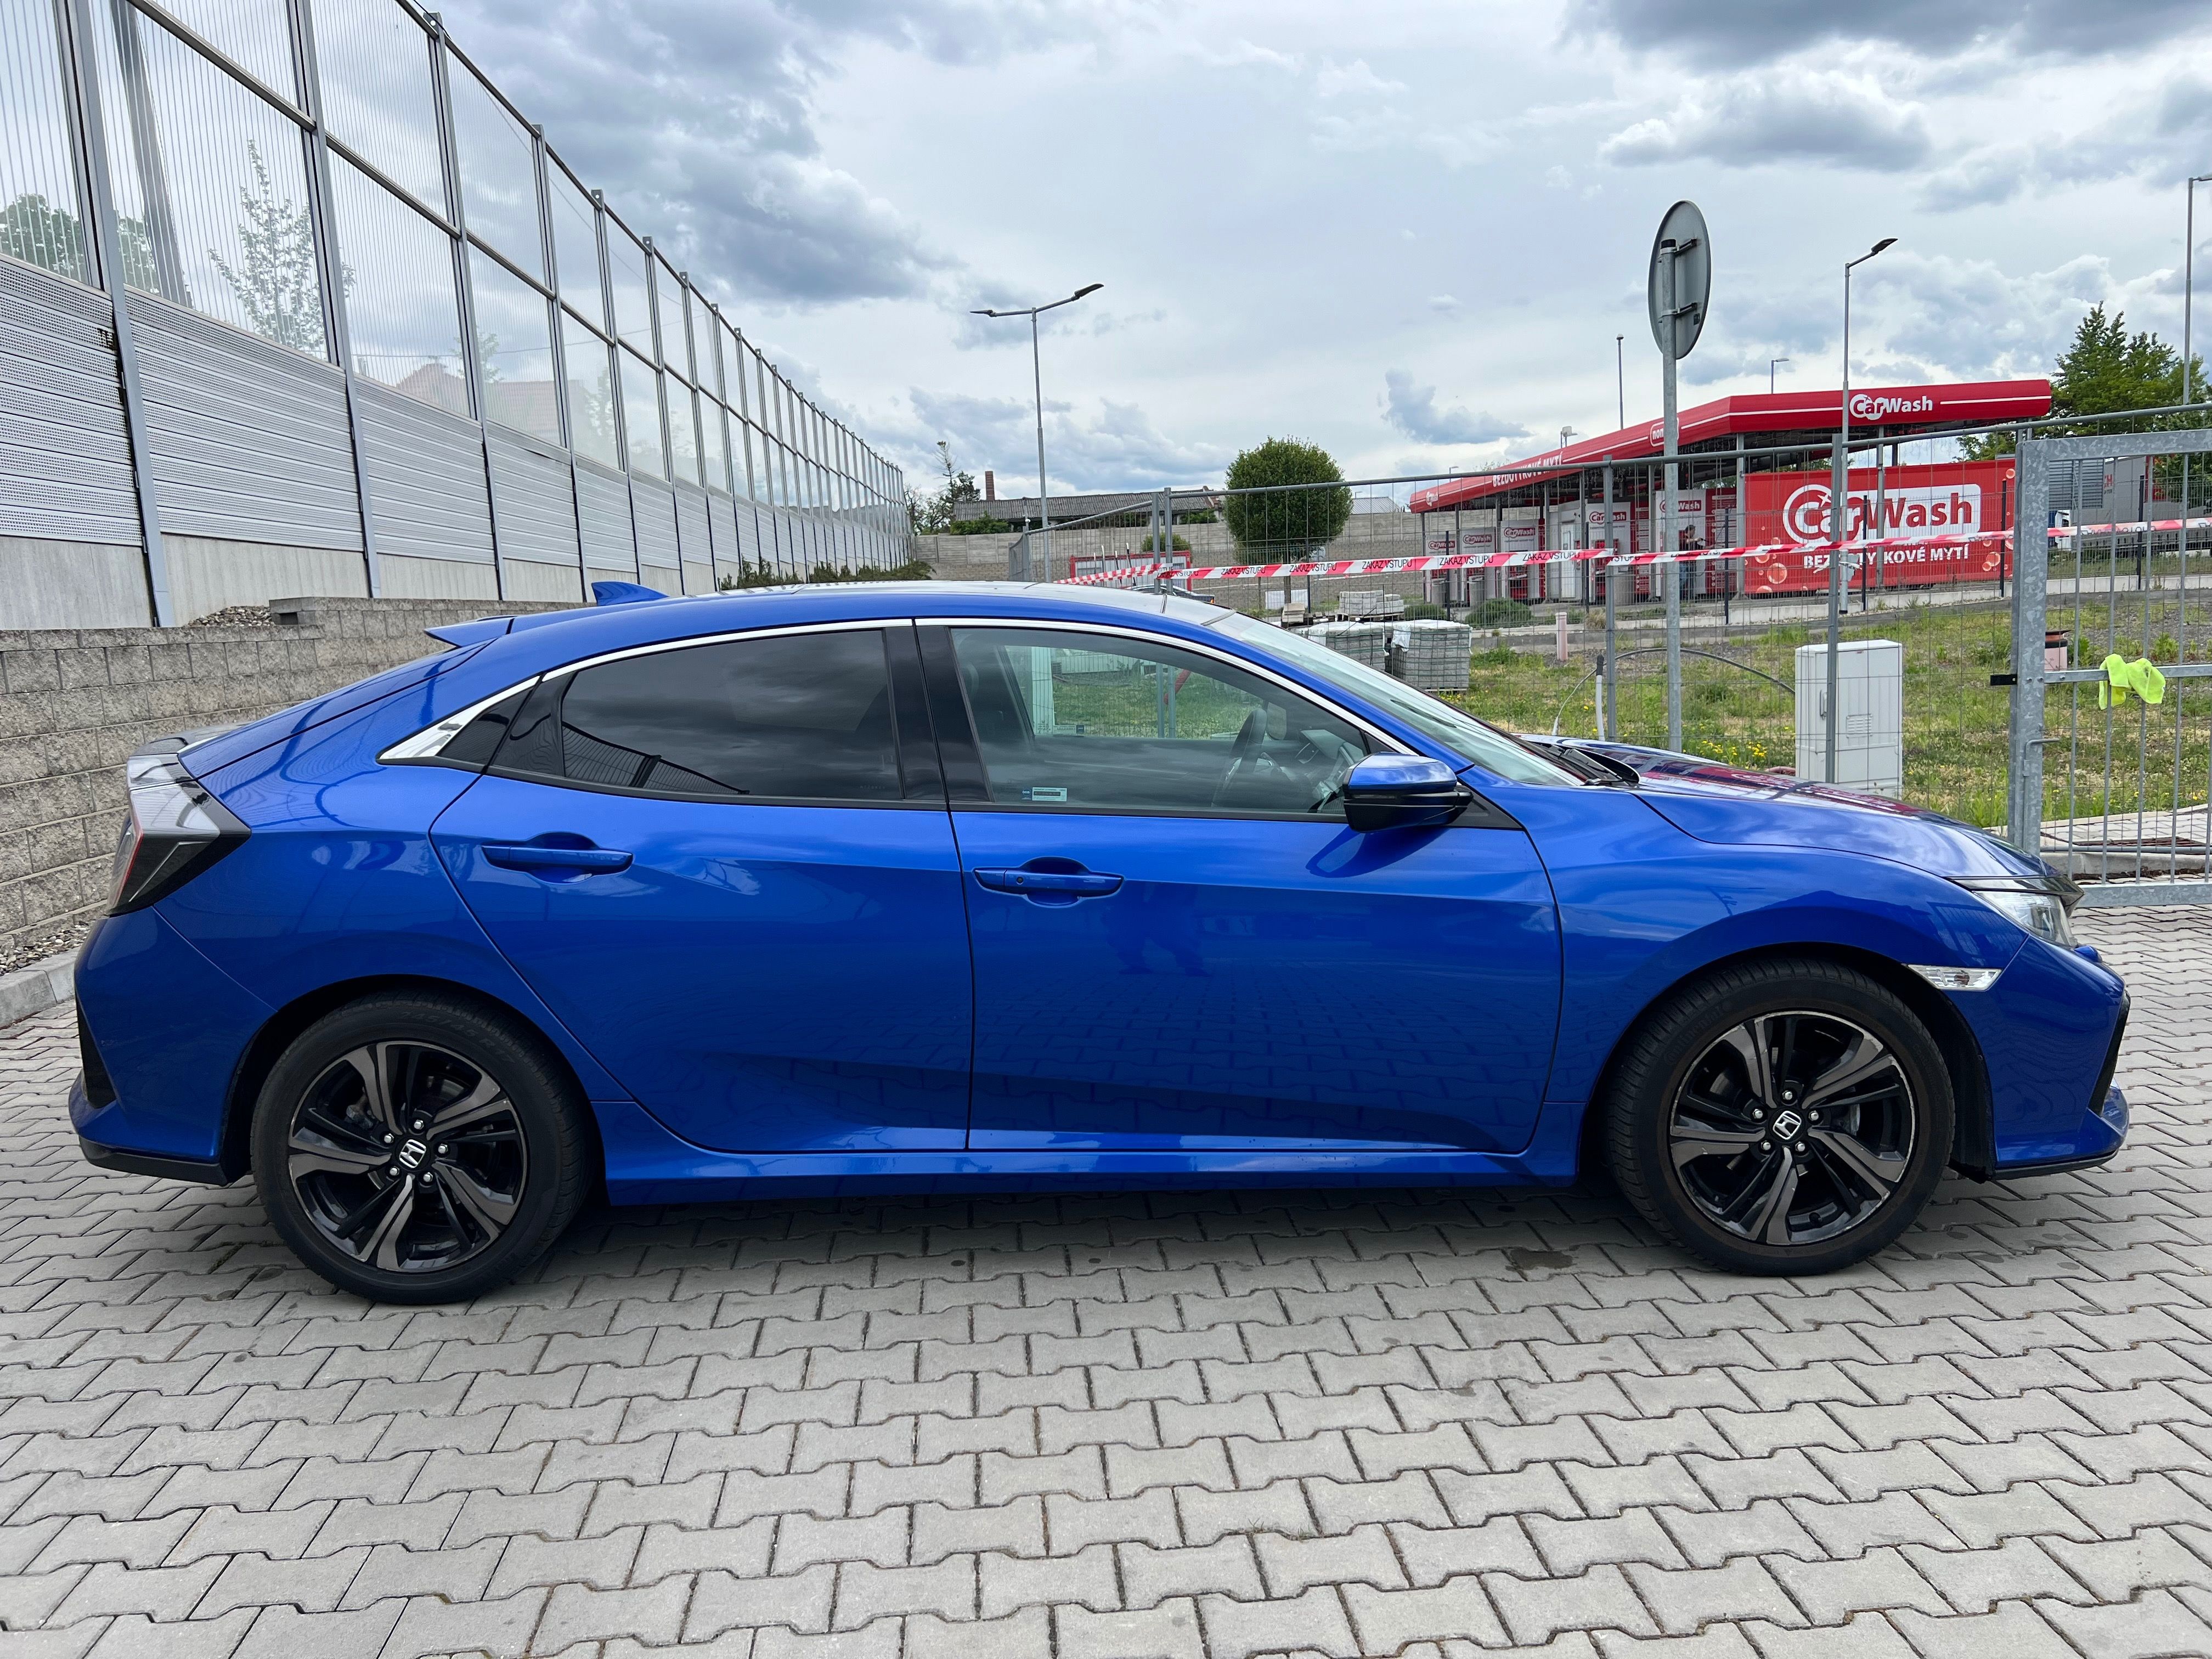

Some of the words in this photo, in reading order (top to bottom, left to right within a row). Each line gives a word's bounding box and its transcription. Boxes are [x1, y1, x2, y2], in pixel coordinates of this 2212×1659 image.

[1851, 394, 1933, 418] CarWash
[1590, 511, 1626, 523] Carash
[1794, 490, 1973, 535] CarWash
[1505, 527, 1534, 538] CarWash
[1440, 556, 1463, 566] ZAKAZ
[1464, 555, 1494, 565] VSTUPU
[1523, 552, 1547, 562] ZAKAZ
[1549, 551, 1580, 560] VSTUPU
[1804, 545, 1925, 568] BEZTYKOVÉ
[1931, 544, 1969, 561] MYTÍ
[1289, 563, 1310, 572] ZAKAZ
[1311, 563, 1337, 572] VSTUPU
[1362, 560, 1384, 569] ZAKAZ
[1385, 559, 1412, 568] VSTUPU
[1242, 566, 1266, 574] VSTUPU
